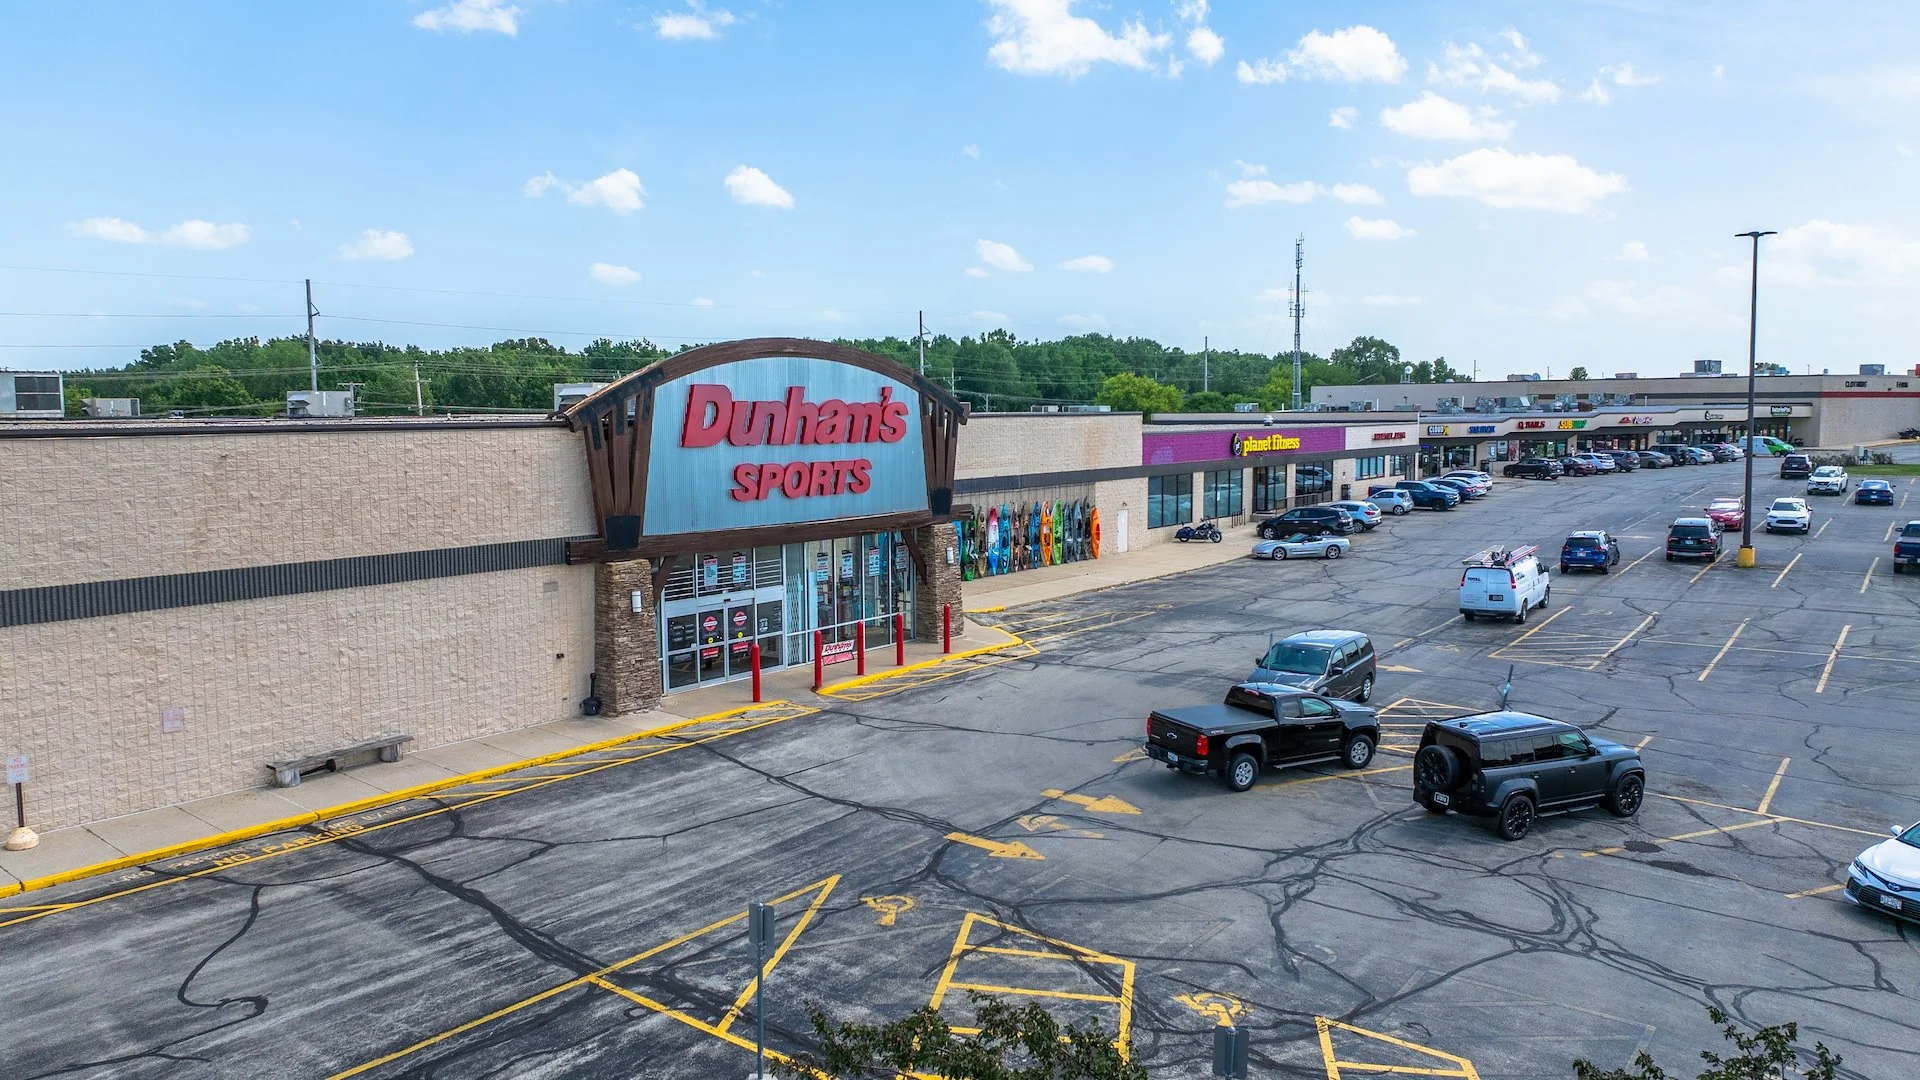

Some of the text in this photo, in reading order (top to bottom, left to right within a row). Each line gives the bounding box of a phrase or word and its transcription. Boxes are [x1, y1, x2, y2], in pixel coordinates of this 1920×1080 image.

[680, 384, 909, 448] Dunham's
[1516, 420, 1524, 429] Q
[1241, 433, 1301, 457] planet fitness
[729, 459, 873, 502] SPORTS
[212, 823, 366, 867] NO PARKING
